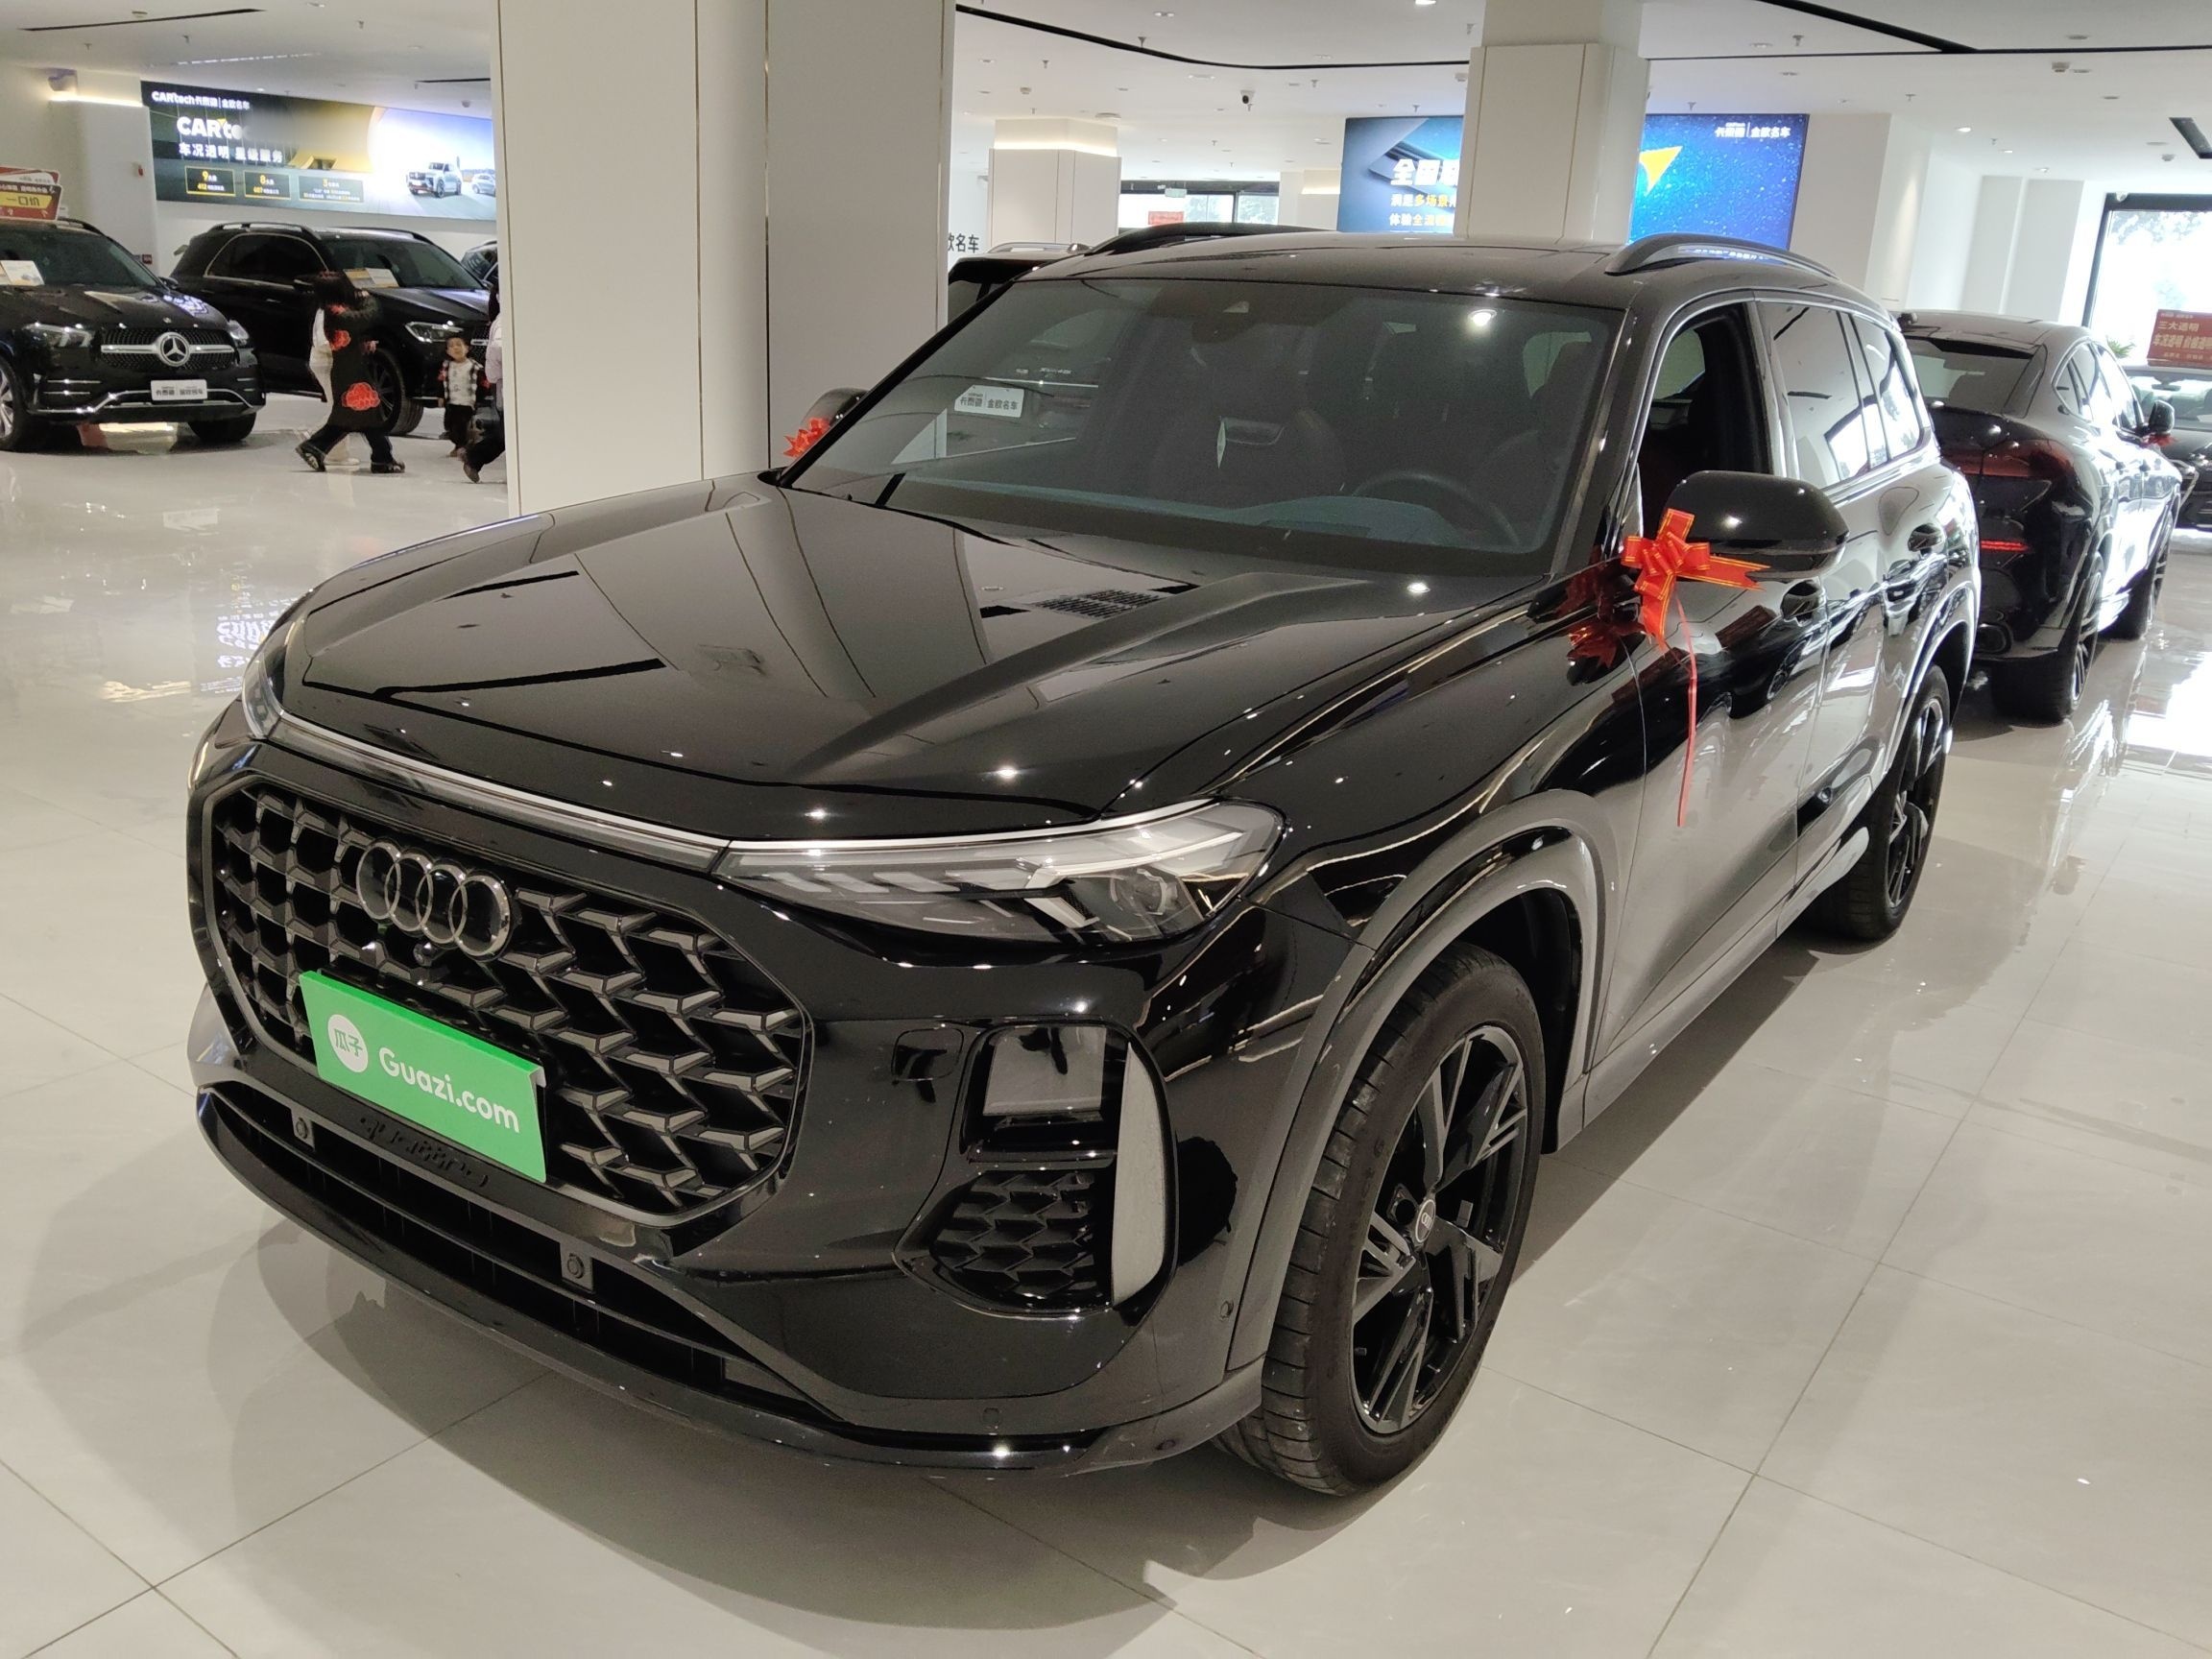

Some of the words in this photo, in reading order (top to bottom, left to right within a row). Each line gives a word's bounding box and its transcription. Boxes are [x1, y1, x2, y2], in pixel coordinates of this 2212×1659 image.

[6, 195, 40, 207] 一口价
[334, 1027, 363, 1057] 瓜子
[378, 1046, 520, 1134] Guazi.com
